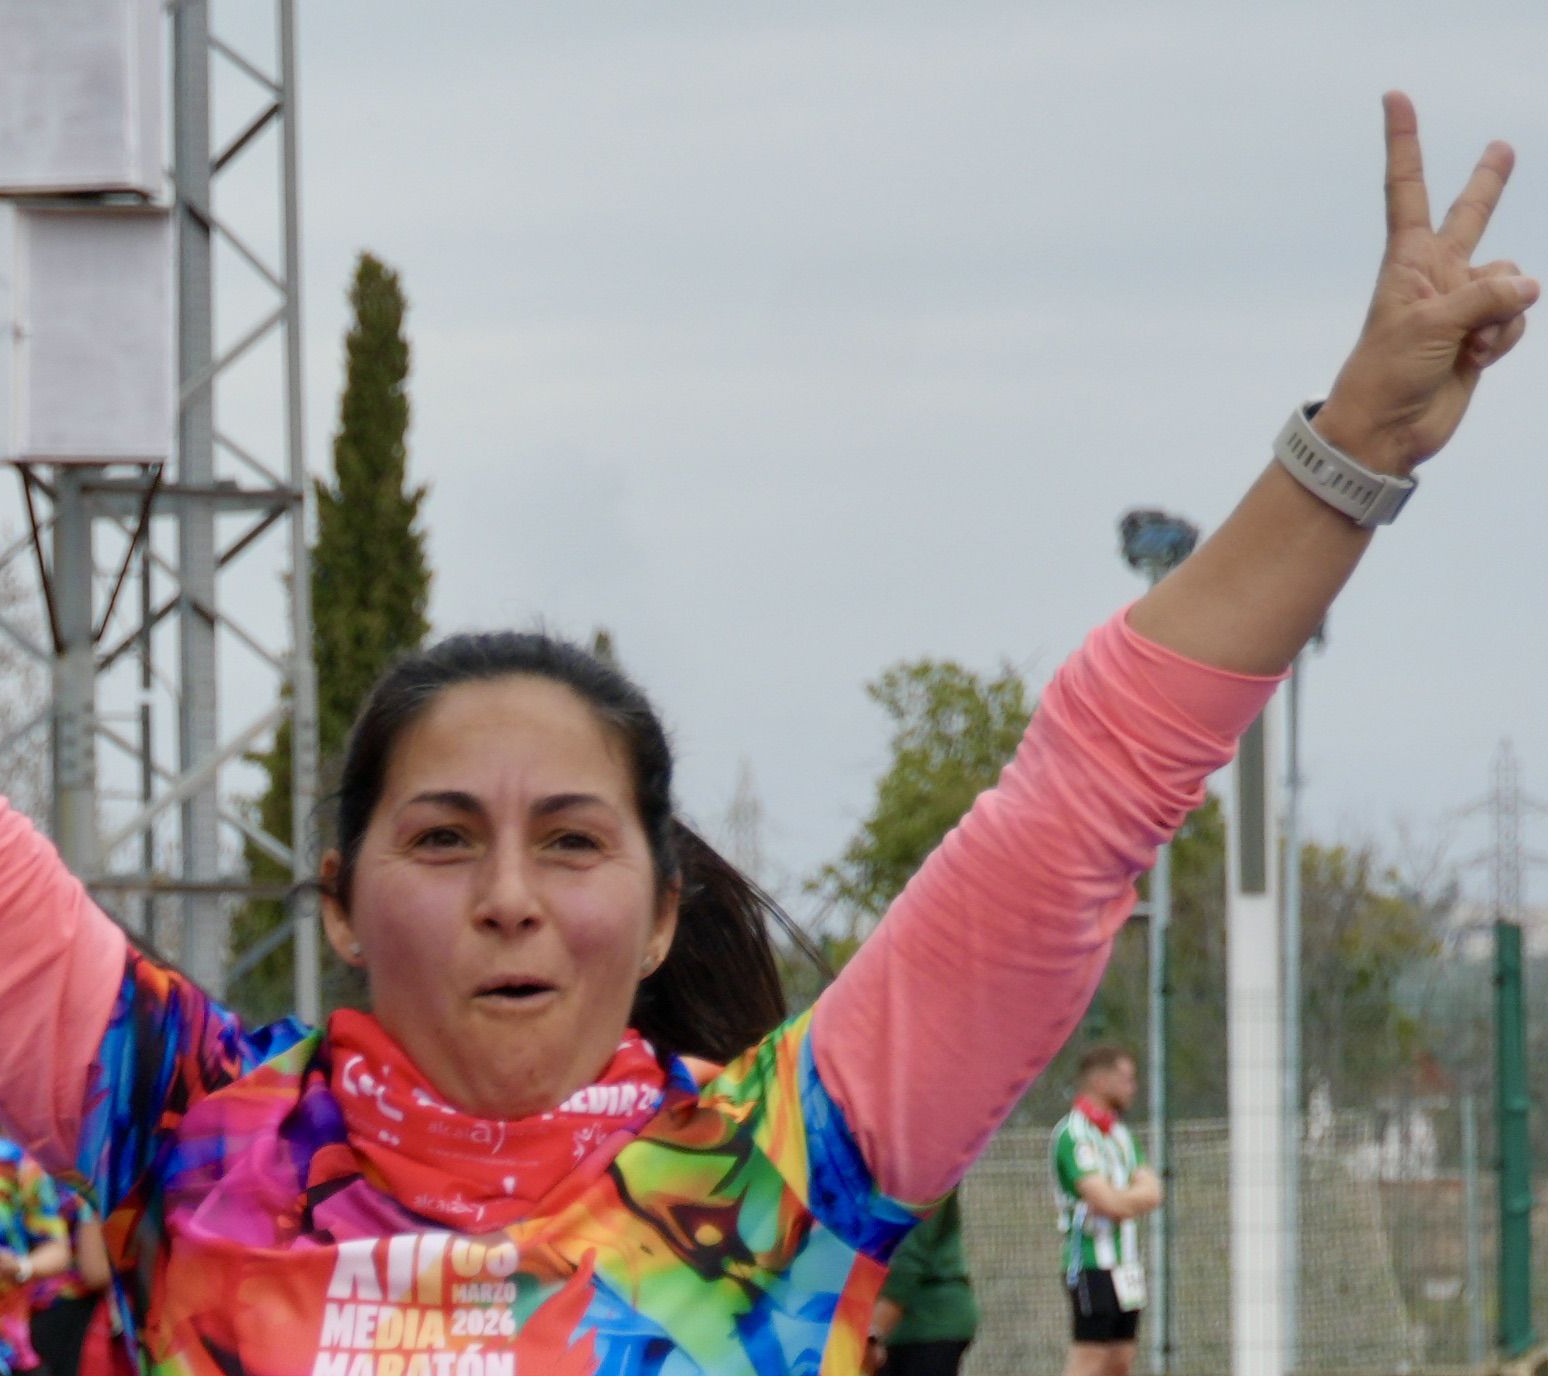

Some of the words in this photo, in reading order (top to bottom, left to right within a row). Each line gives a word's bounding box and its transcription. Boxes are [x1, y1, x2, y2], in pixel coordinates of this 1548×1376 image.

[452, 1282, 517, 1304] MARZO
[319, 1302, 447, 1350] MEDIA
[451, 1307, 516, 1337] 2026
